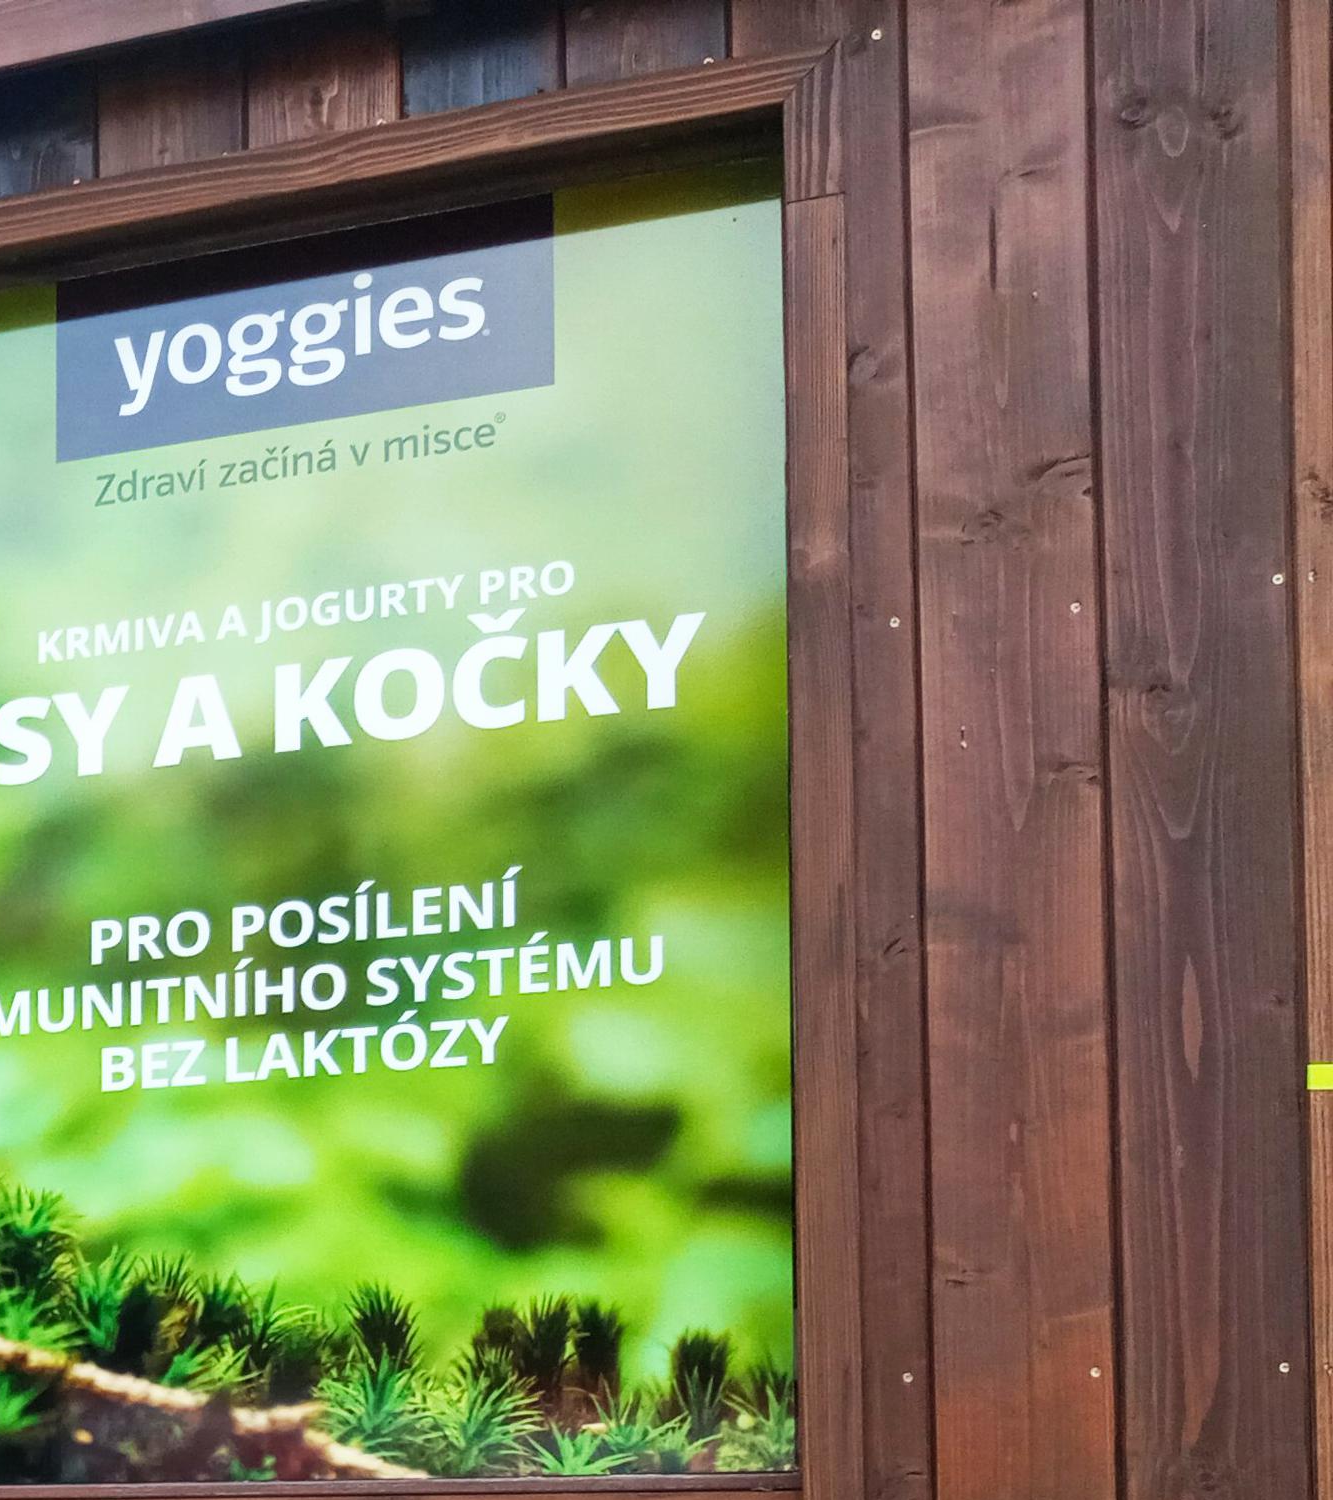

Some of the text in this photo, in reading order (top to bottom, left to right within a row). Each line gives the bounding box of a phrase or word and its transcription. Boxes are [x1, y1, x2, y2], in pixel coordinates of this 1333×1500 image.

[113, 271, 488, 416] yoggies
[93, 459, 206, 508] Zdraví
[217, 439, 336, 488] začíná
[350, 442, 373, 467] v
[36, 559, 576, 665] KRMIVA A JOGURTY PRO
[152, 673, 243, 769] A
[272, 608, 708, 755] KOČKY
[90, 864, 524, 966] PRO POSÍLENÍ
[365, 933, 666, 1007] SYSTÉMU
[99, 1012, 510, 1094] BEZ LAKTÓZY
